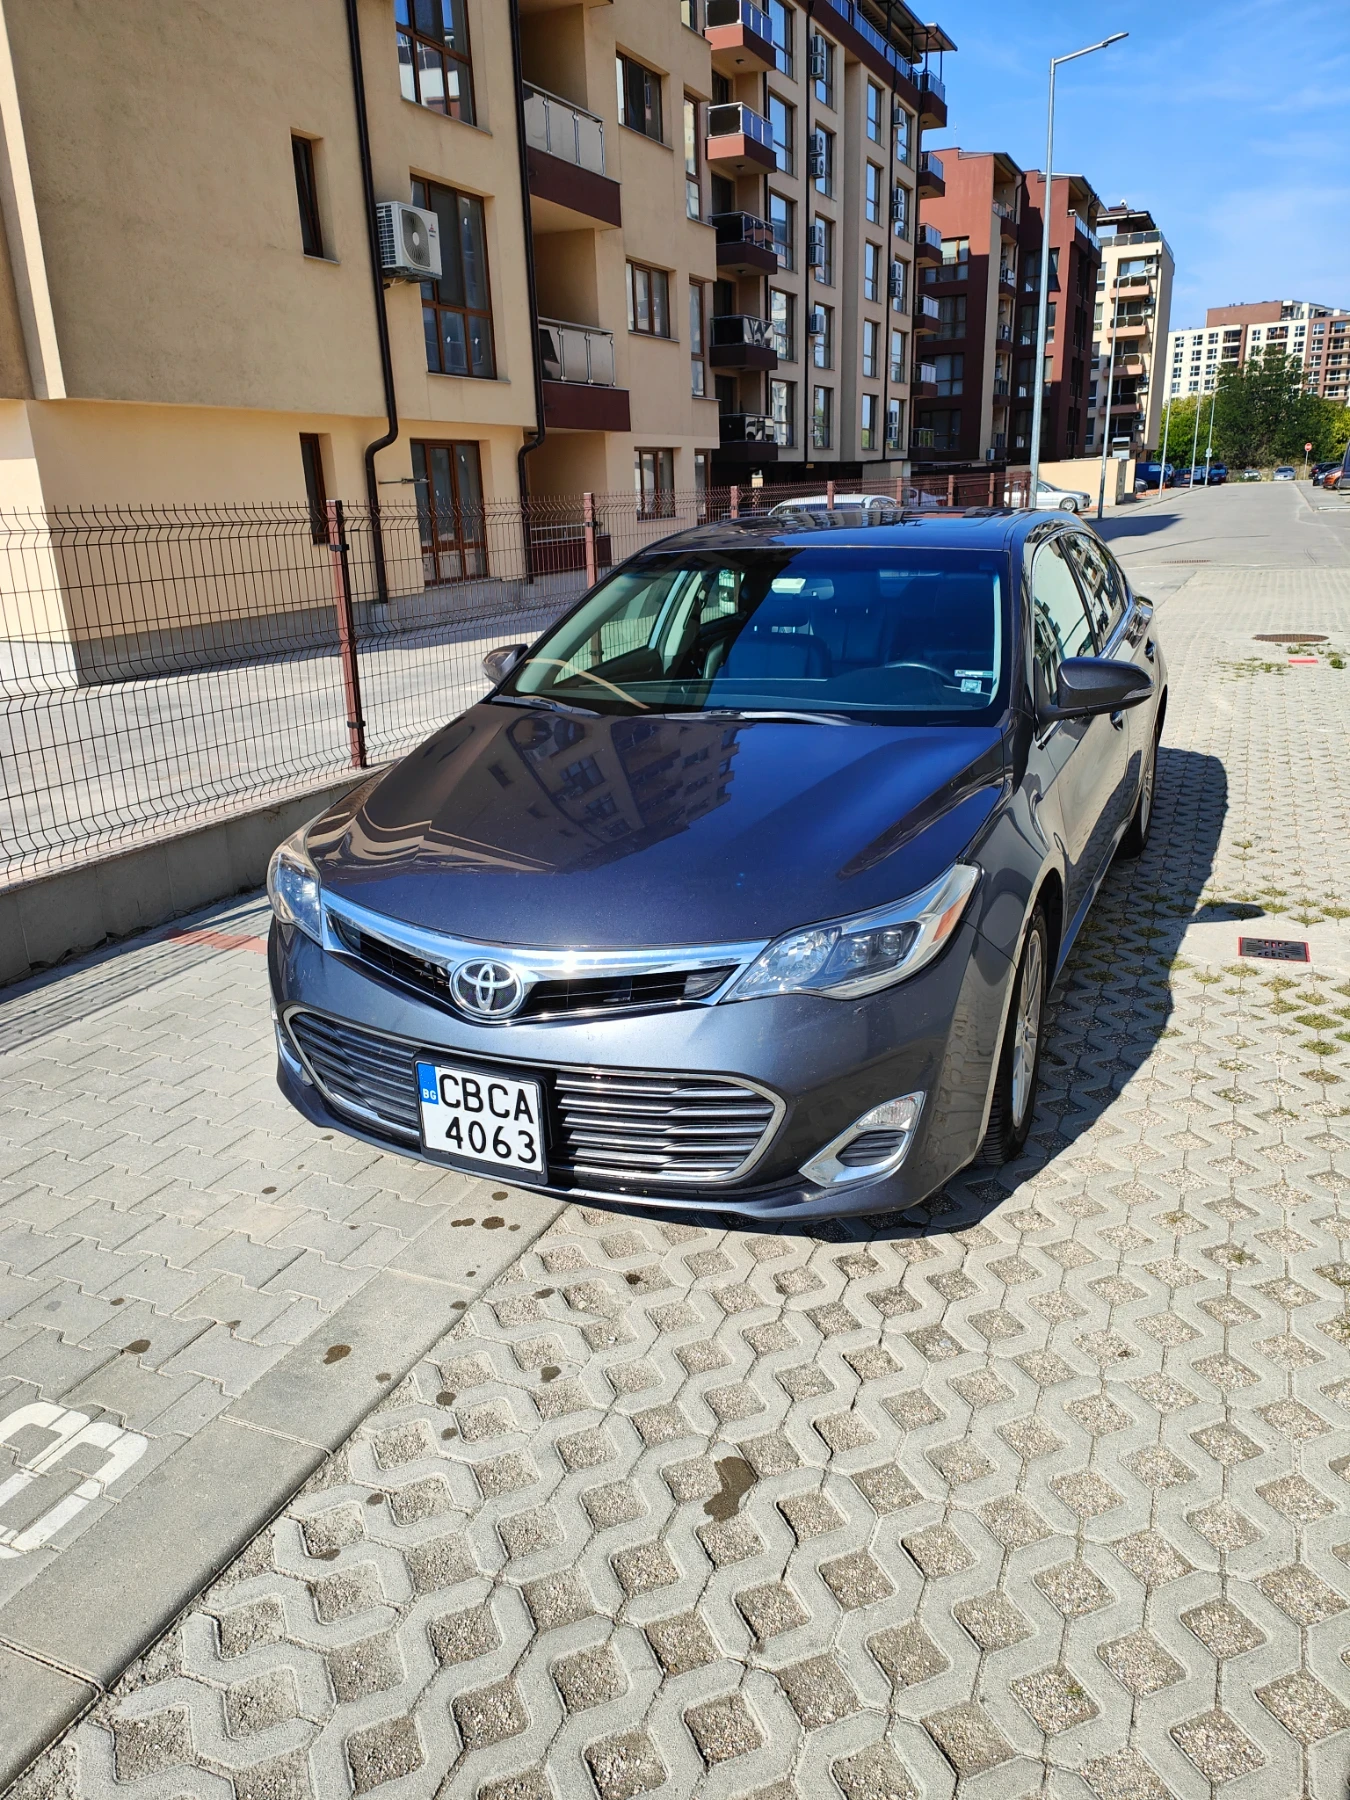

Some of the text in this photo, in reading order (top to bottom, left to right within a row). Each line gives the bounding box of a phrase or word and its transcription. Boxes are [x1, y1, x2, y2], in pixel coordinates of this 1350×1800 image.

[422, 1088, 437, 1100] BG
[439, 1073, 534, 1124] CBCA
[445, 1116, 537, 1164] 4063
